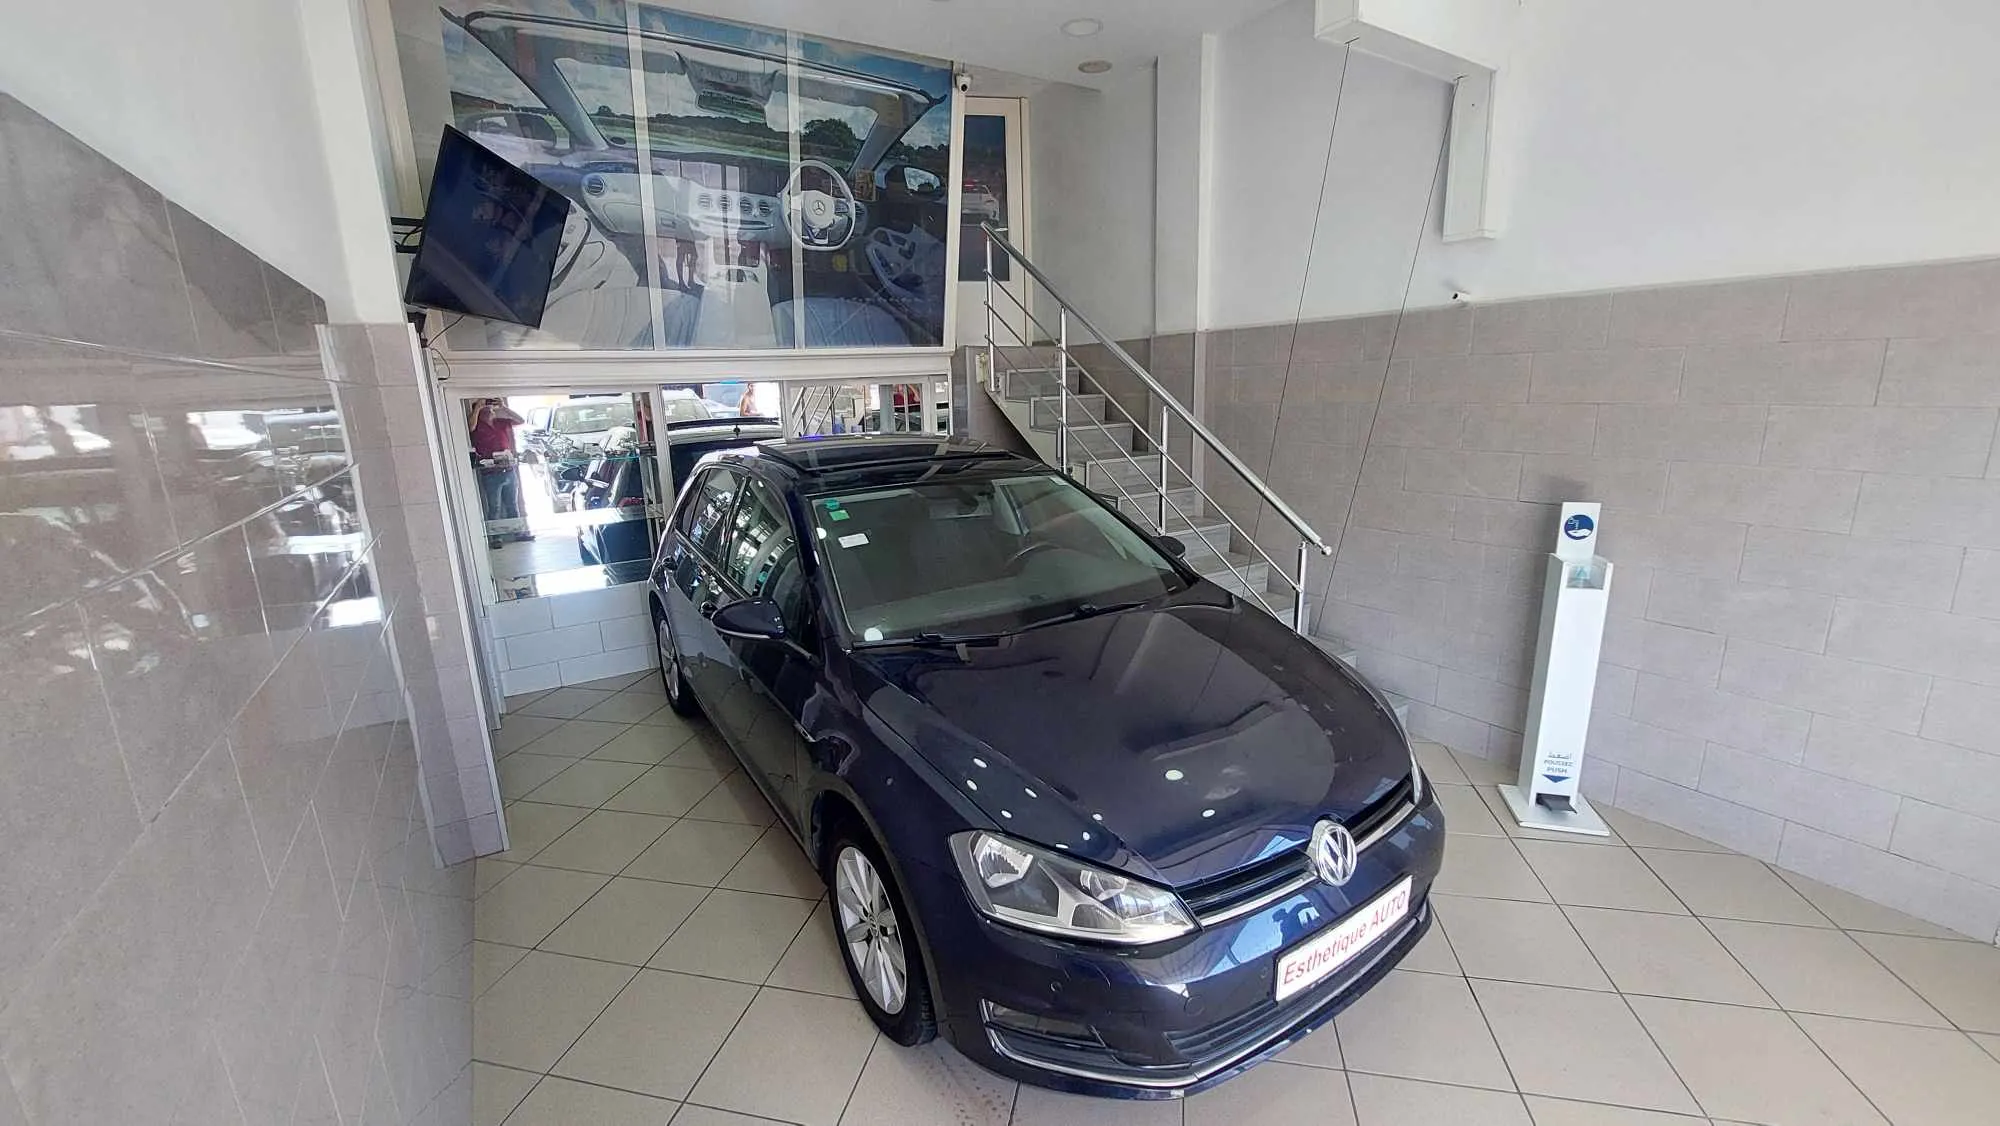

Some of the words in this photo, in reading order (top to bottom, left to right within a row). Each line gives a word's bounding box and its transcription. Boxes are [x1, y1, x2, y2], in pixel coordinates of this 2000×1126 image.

[1546, 766, 1568, 774] PUSH
[1283, 922, 1367, 985] Esthetique
[1369, 890, 1406, 931] AUTO
